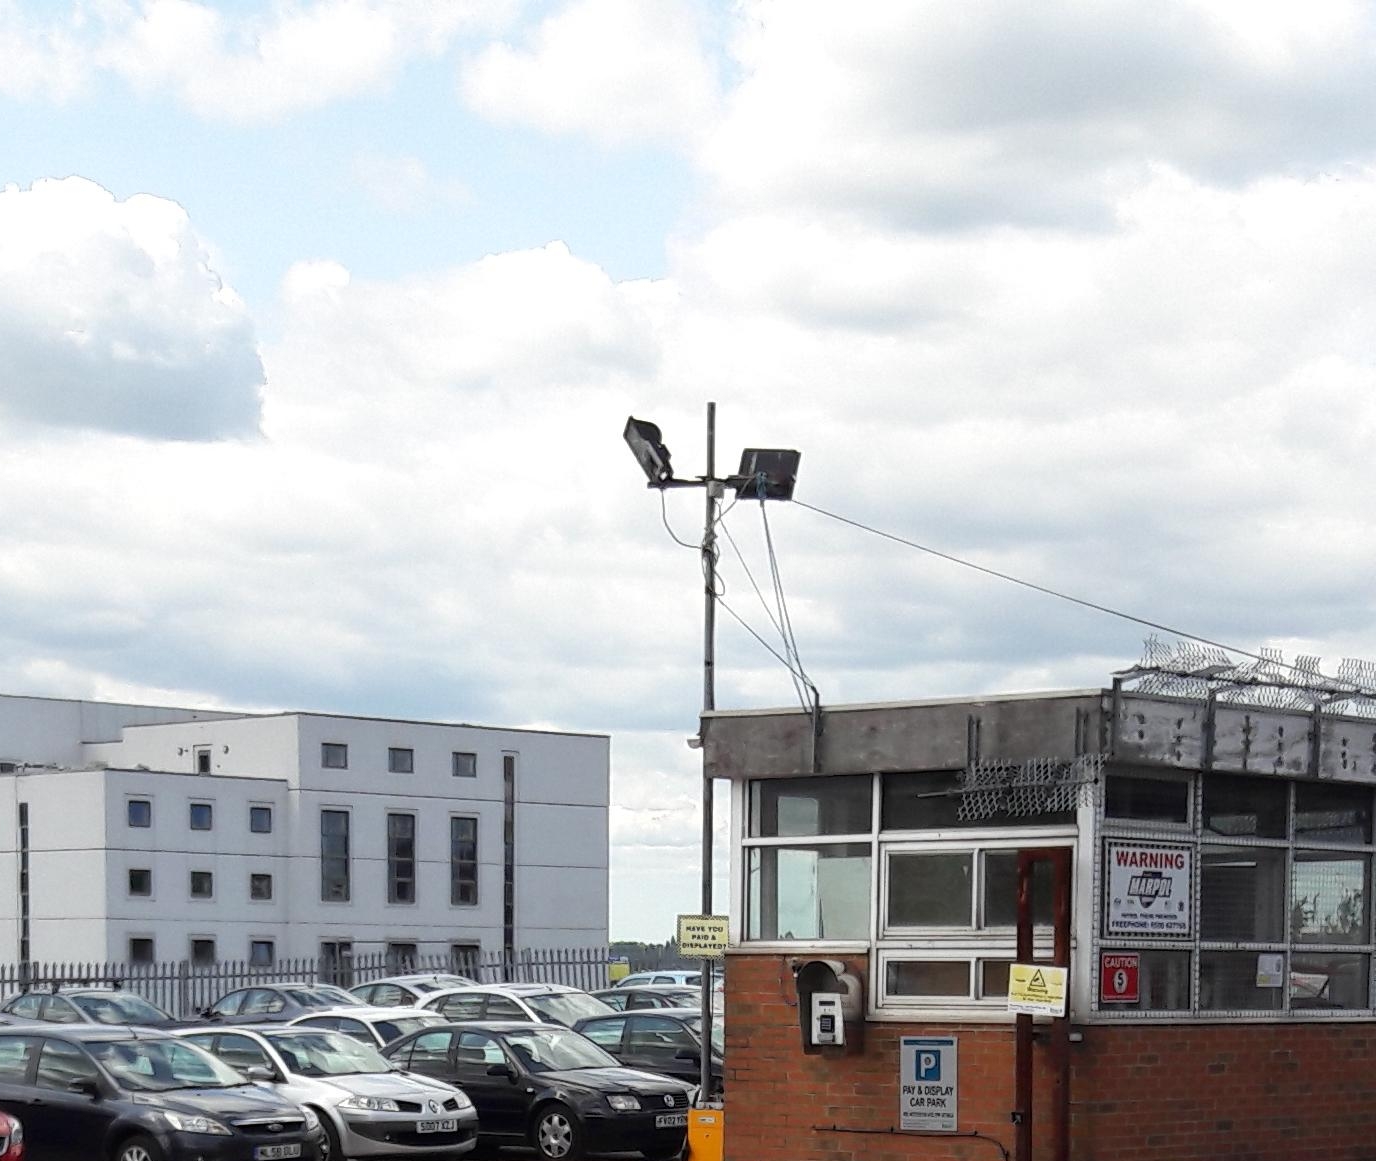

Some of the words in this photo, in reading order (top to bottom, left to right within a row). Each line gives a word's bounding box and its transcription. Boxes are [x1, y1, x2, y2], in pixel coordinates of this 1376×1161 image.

[1116, 850, 1185, 870] WARNING
[1128, 876, 1172, 898] MARPOL
[1104, 956, 1138, 968] CAUTION
[920, 1053, 936, 1079] P
[903, 1085, 916, 1096] PAY
[917, 1086, 923, 1095] &
[924, 1086, 954, 1097] DISPLAY
[910, 1097, 925, 1108] CAR
[926, 1098, 947, 1108] PARK
